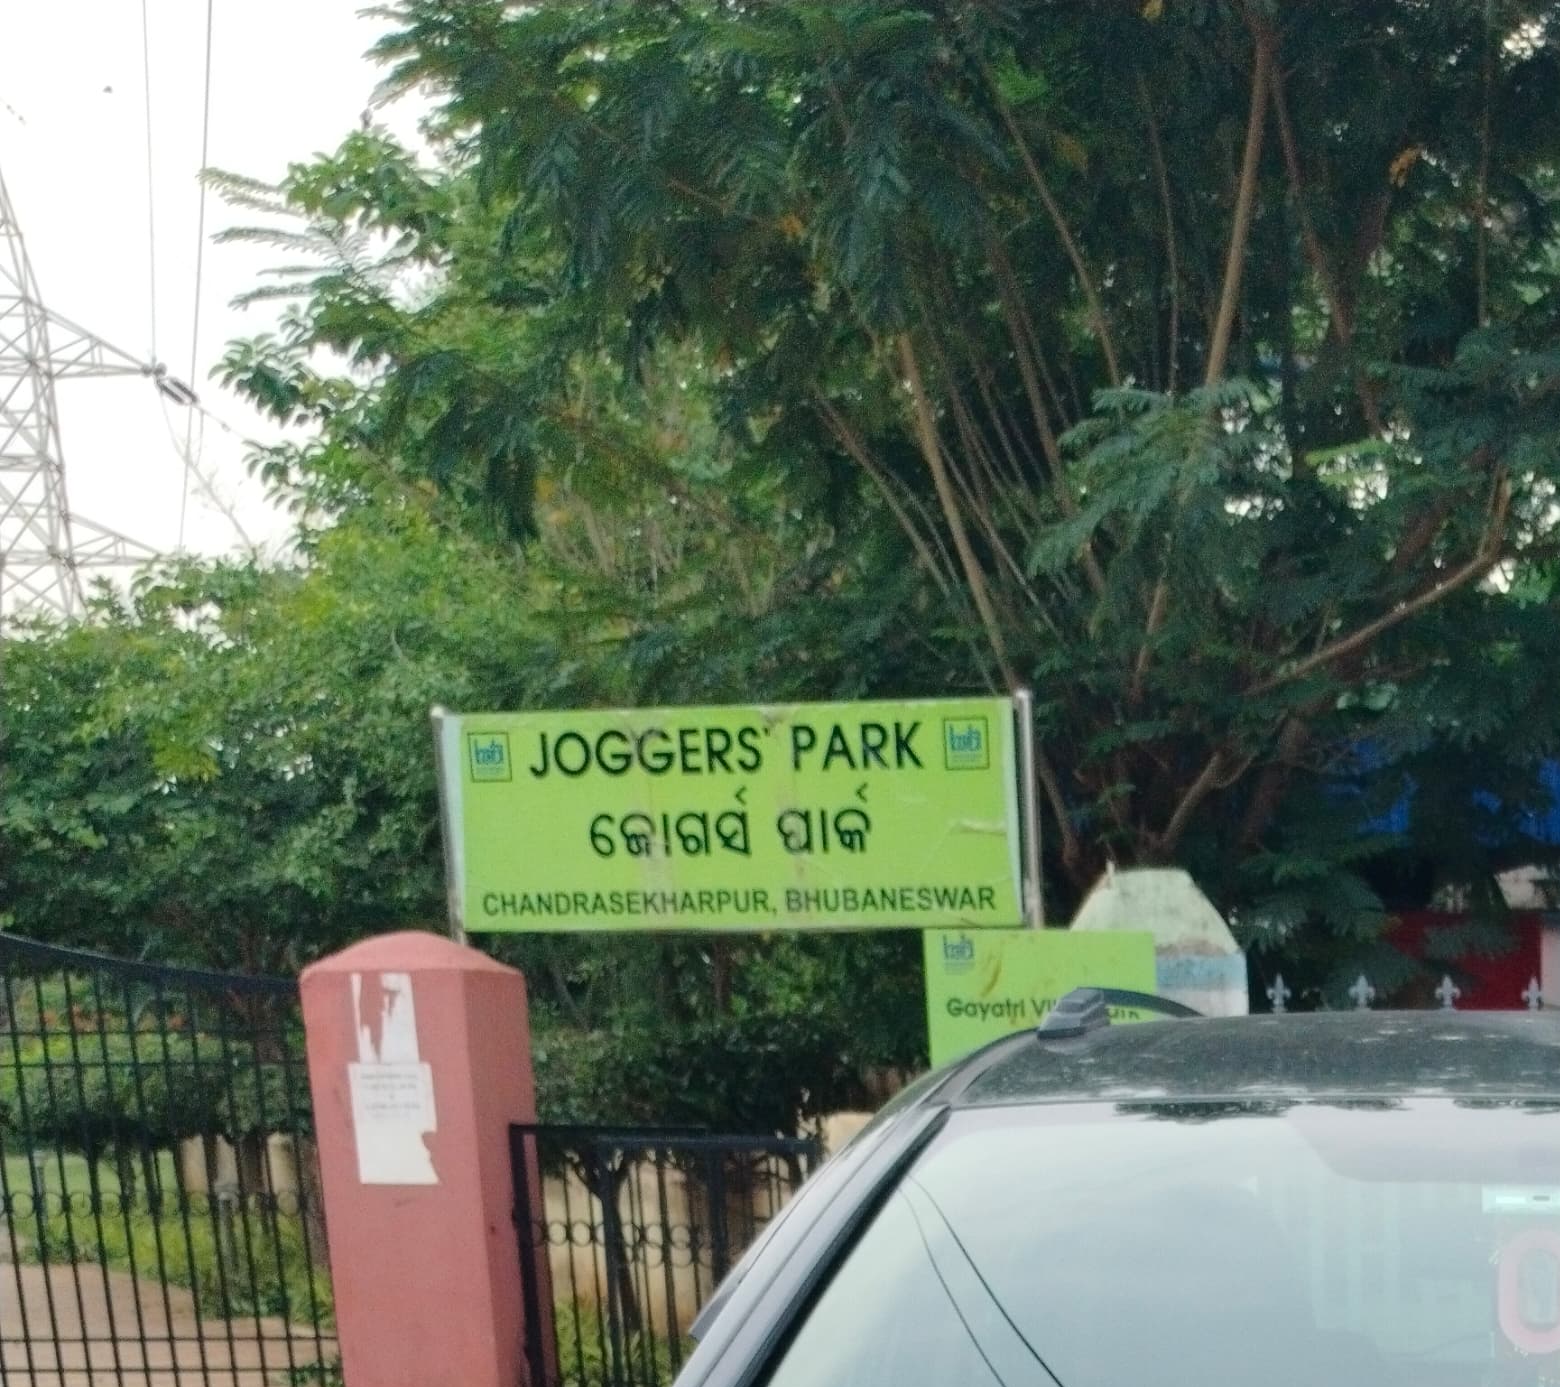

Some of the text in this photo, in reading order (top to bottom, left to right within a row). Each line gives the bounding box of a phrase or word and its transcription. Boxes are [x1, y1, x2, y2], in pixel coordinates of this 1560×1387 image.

[790, 721, 924, 772] PARK
[775, 783, 872, 854] ପାର୍କ
[483, 886, 997, 917] CHANDRASEKHARPUR, BHUBANESWAR
[946, 997, 1025, 1022] Gayatri
